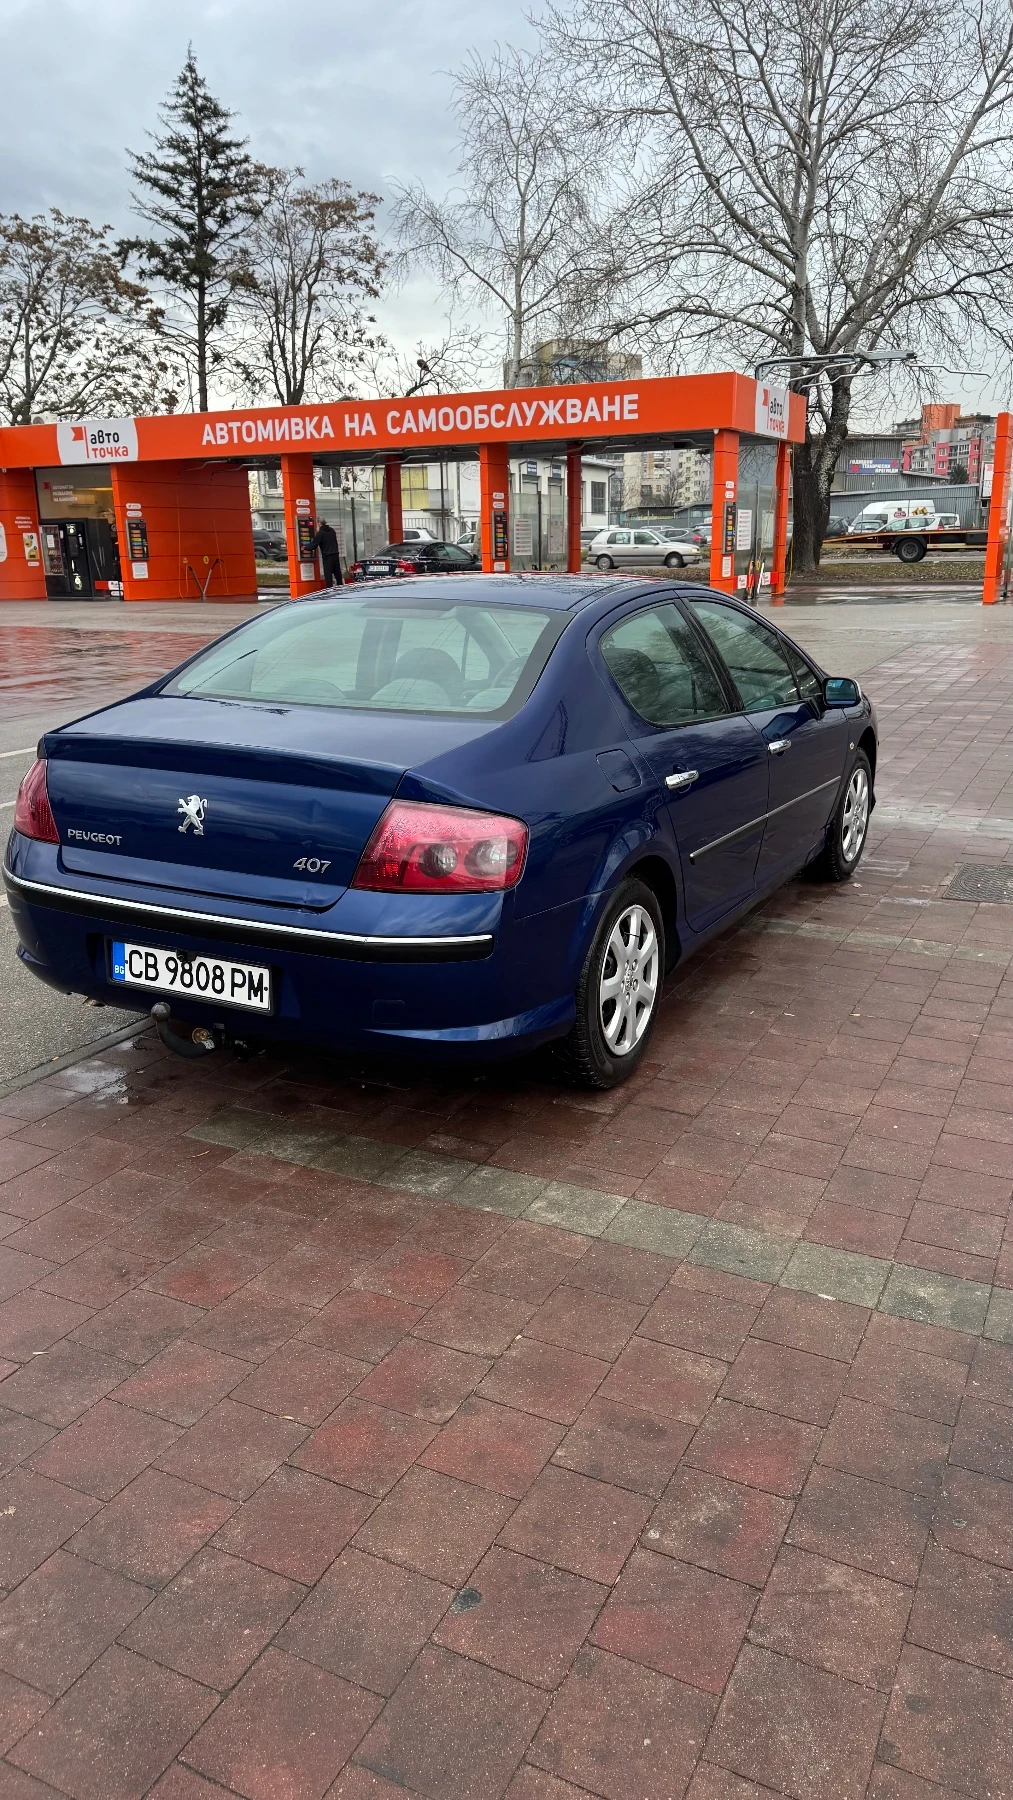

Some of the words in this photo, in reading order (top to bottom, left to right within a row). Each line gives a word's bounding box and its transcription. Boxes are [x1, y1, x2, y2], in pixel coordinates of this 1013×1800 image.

[202, 415, 335, 446] АВТОМИВКА
[344, 412, 377, 438] НА
[386, 393, 639, 435] САМООБСЛУЖВАНЕ
[90, 429, 120, 445] авто
[91, 445, 129, 459] точка
[67, 828, 123, 846] PEUGEOT
[292, 857, 332, 874] 407
[114, 964, 125, 974] BG
[128, 949, 160, 982] CB
[164, 956, 225, 995] 9808
[230, 967, 264, 1004] PM
